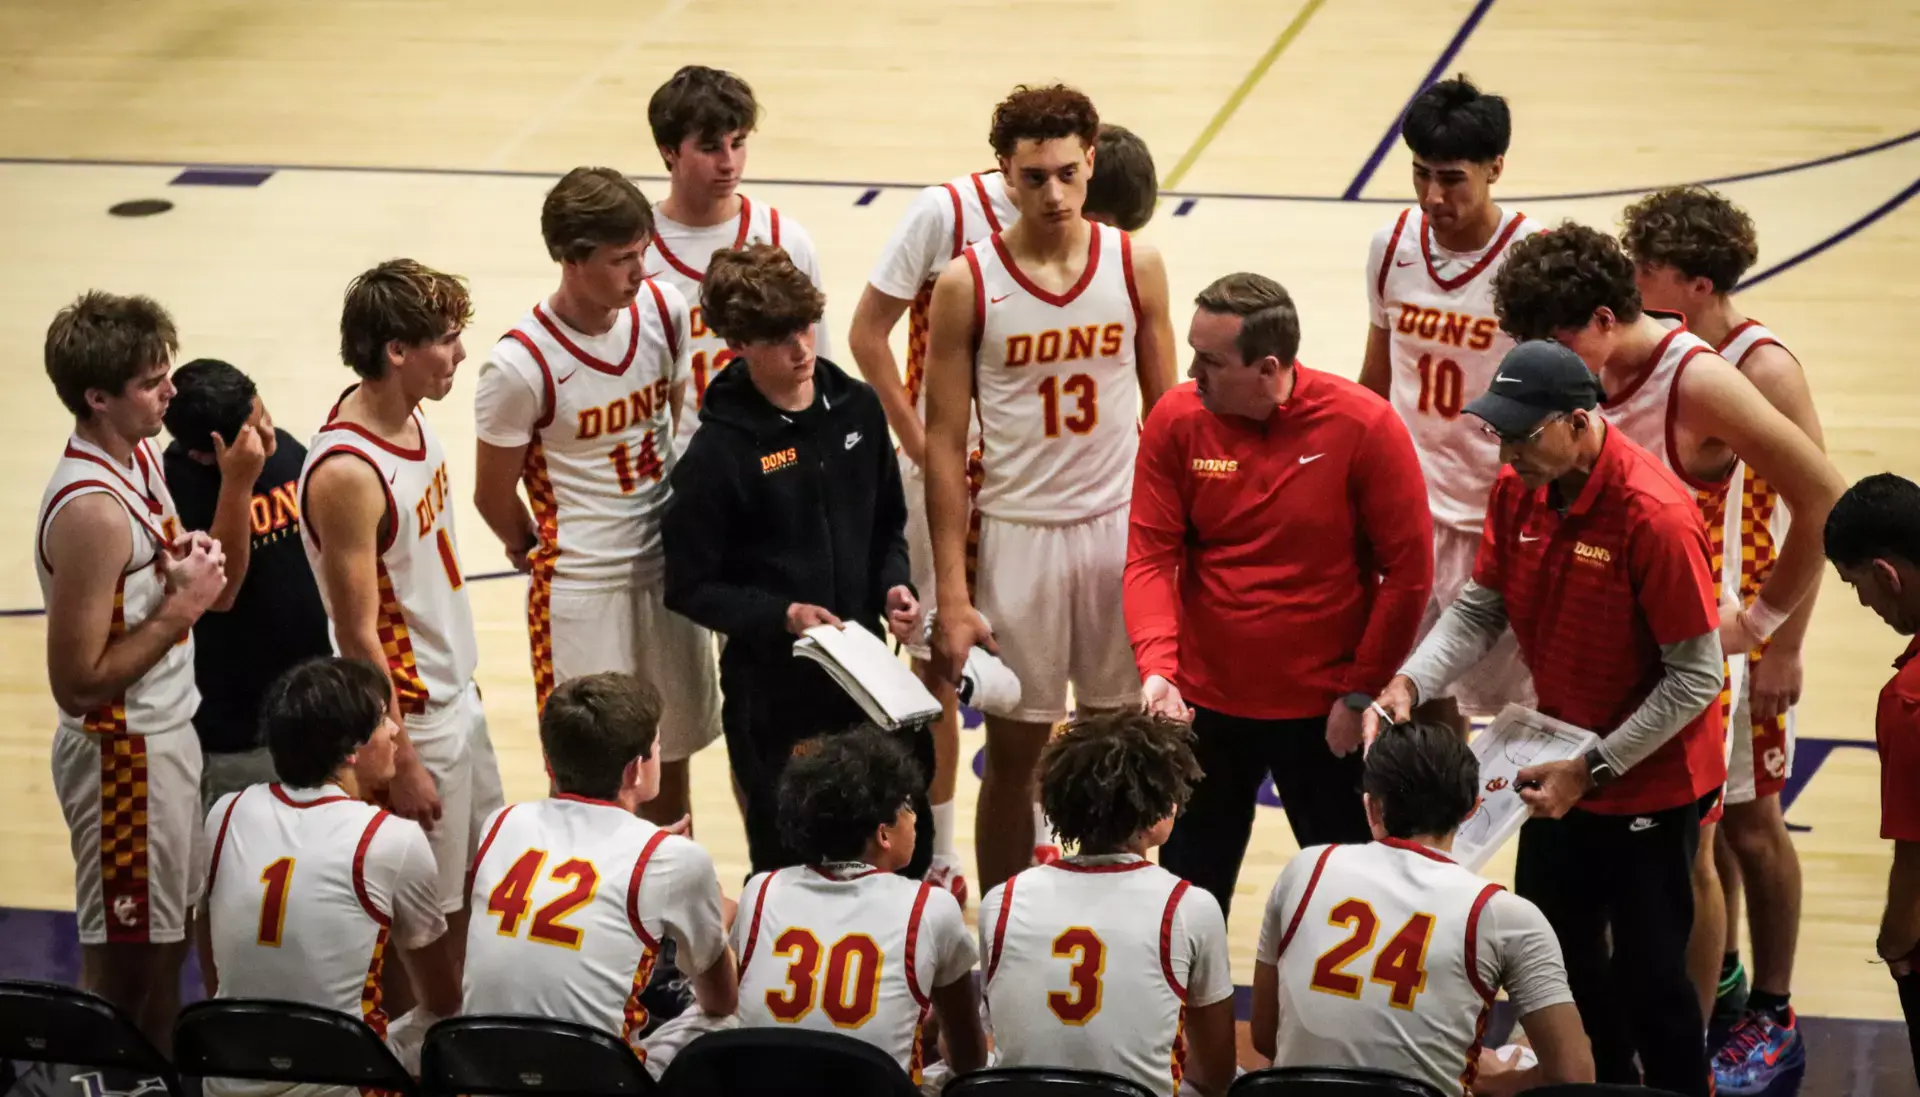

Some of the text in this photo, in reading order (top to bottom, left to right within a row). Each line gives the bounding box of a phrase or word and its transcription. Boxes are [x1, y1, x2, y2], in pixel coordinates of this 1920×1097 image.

[1003, 321, 1125, 367] DONS
[1396, 303, 1498, 350] DONS
[576, 376, 670, 440] DONS
[1037, 372, 1098, 439] 13
[1416, 353, 1464, 421] 10
[608, 429, 664, 494] 14
[760, 447, 797, 471] DONS
[1192, 458, 1238, 472] DONS
[1573, 541, 1611, 562] DONS
[256, 856, 297, 948] 1
[487, 847, 601, 951] 42
[764, 926, 885, 1030] 30
[1047, 925, 1107, 1027] 3
[1310, 896, 1436, 1012] 24
